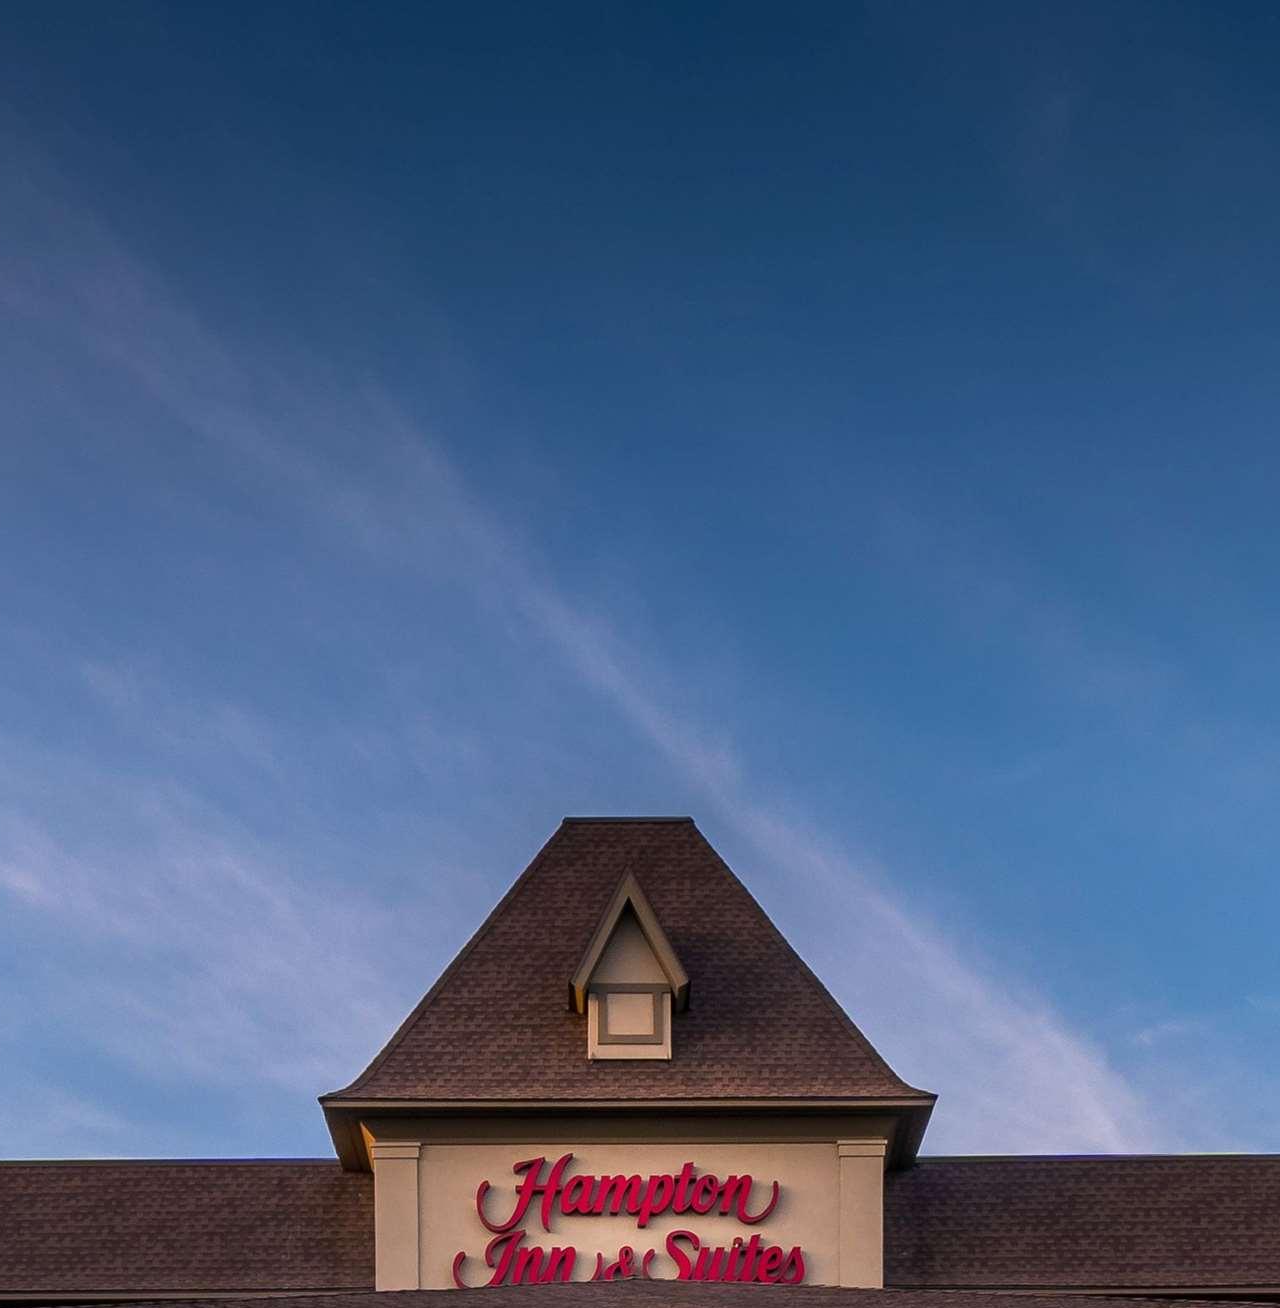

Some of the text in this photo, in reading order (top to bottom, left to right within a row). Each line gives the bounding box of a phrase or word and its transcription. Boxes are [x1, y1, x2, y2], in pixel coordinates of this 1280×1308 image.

[476, 1152, 779, 1233] Hampton
[453, 1229, 602, 1288] Inn
[642, 1230, 805, 1284] Suites
